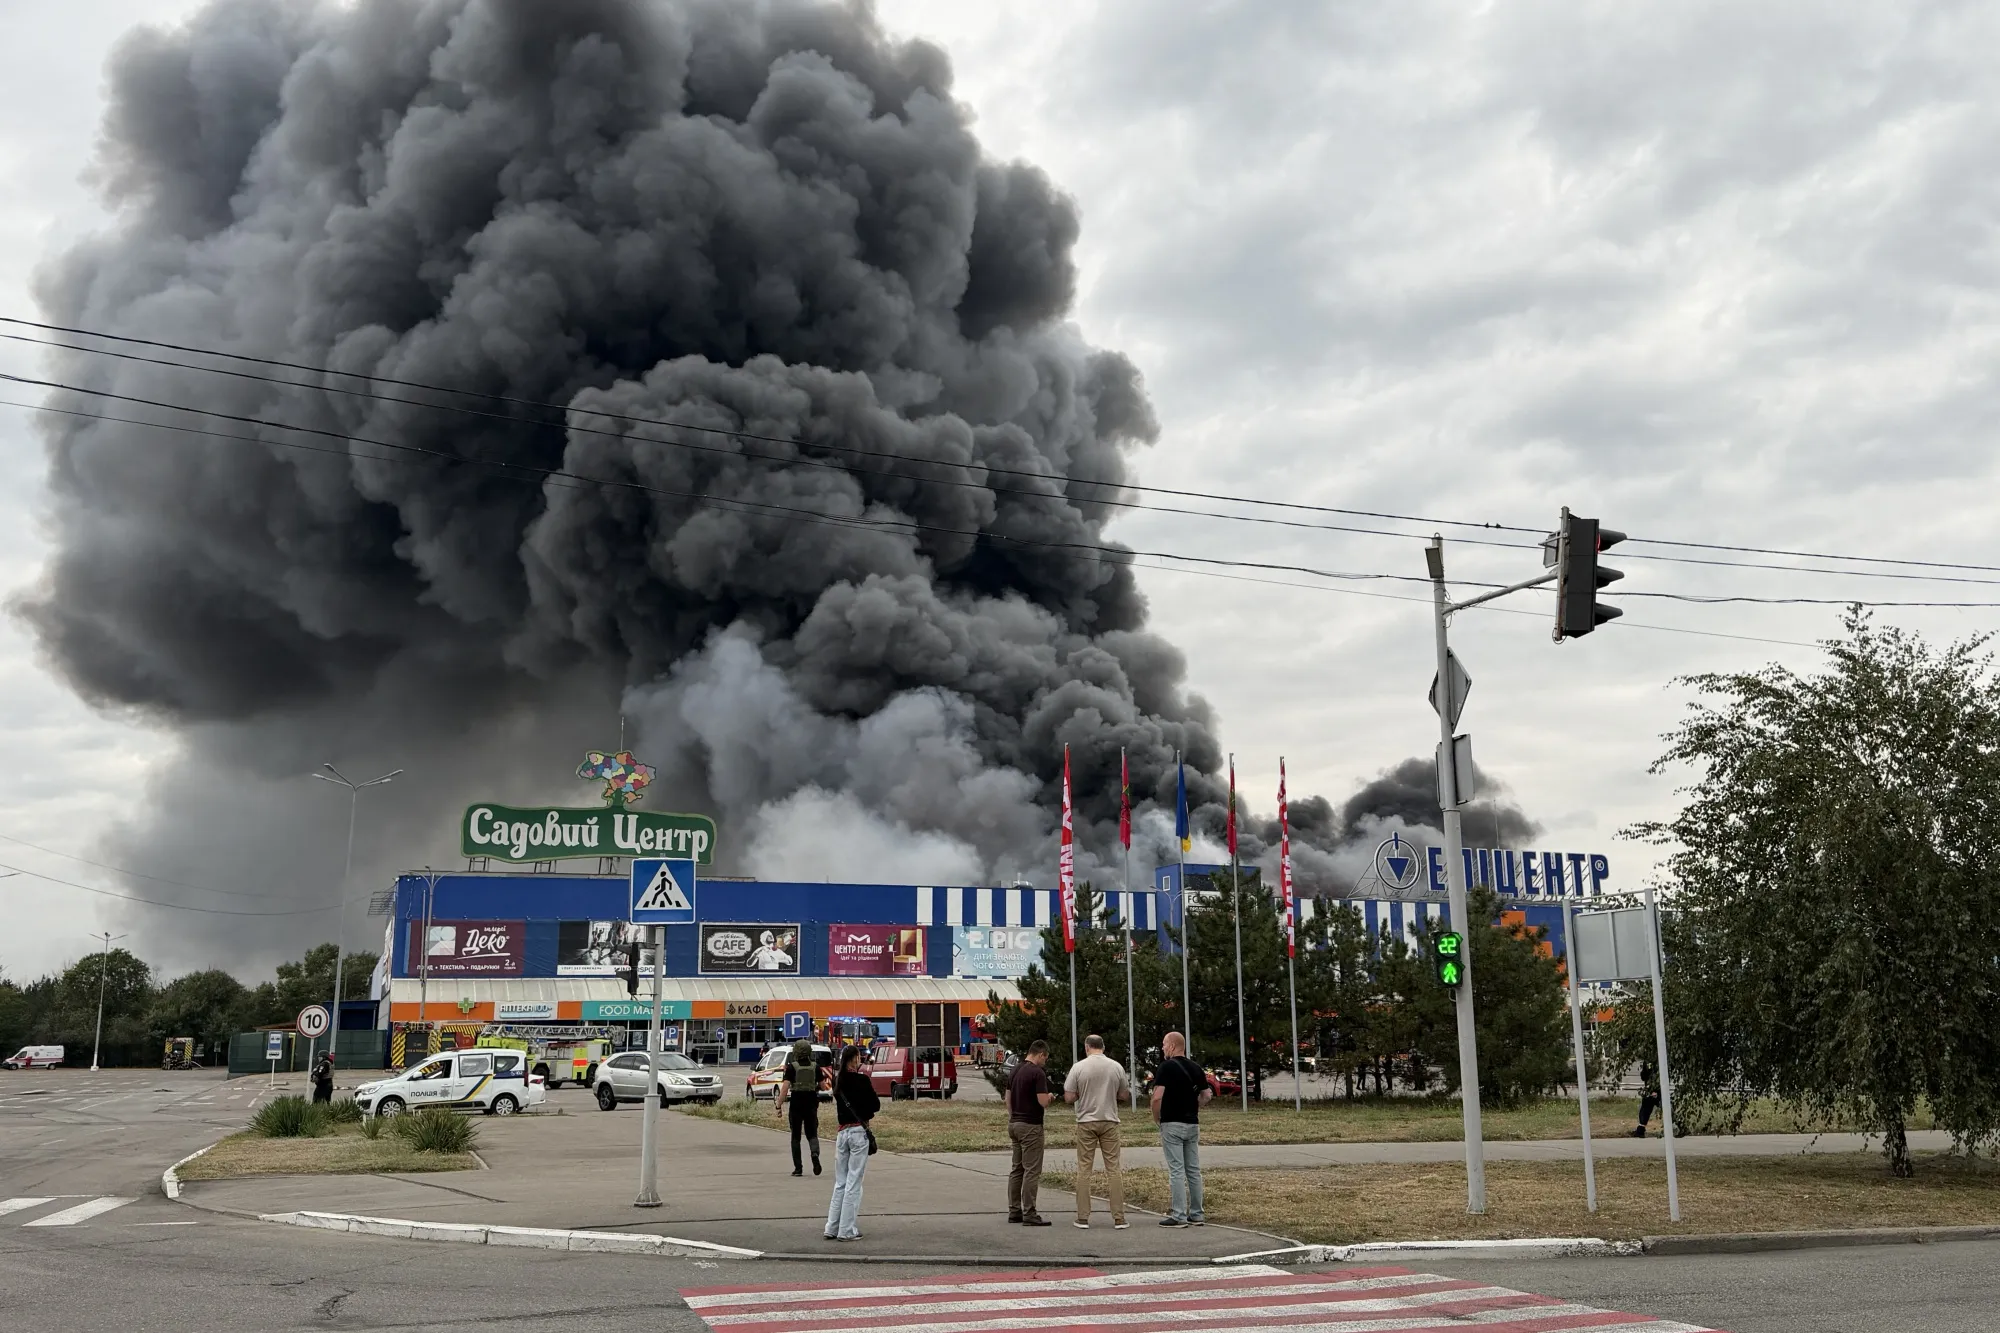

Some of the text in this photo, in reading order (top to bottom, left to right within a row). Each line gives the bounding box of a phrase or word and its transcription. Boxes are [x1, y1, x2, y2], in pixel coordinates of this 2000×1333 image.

[469, 807, 709, 862] Садовий Центр
[462, 929, 507, 956] Деко
[713, 939, 746, 951] CAFE
[1438, 938, 1457, 953] 22
[834, 945, 883, 955] ЦЕНТР МЕБЛІВ
[973, 953, 992, 961] ДІТИ
[973, 962, 994, 970] ЧОГО
[599, 1005, 631, 1015] FOOD
[737, 1004, 768, 1014] КАФЕ
[305, 1013, 323, 1029] 10
[791, 1015, 805, 1035] P
[410, 1090, 438, 1098] ПОЛІЦІЯ
